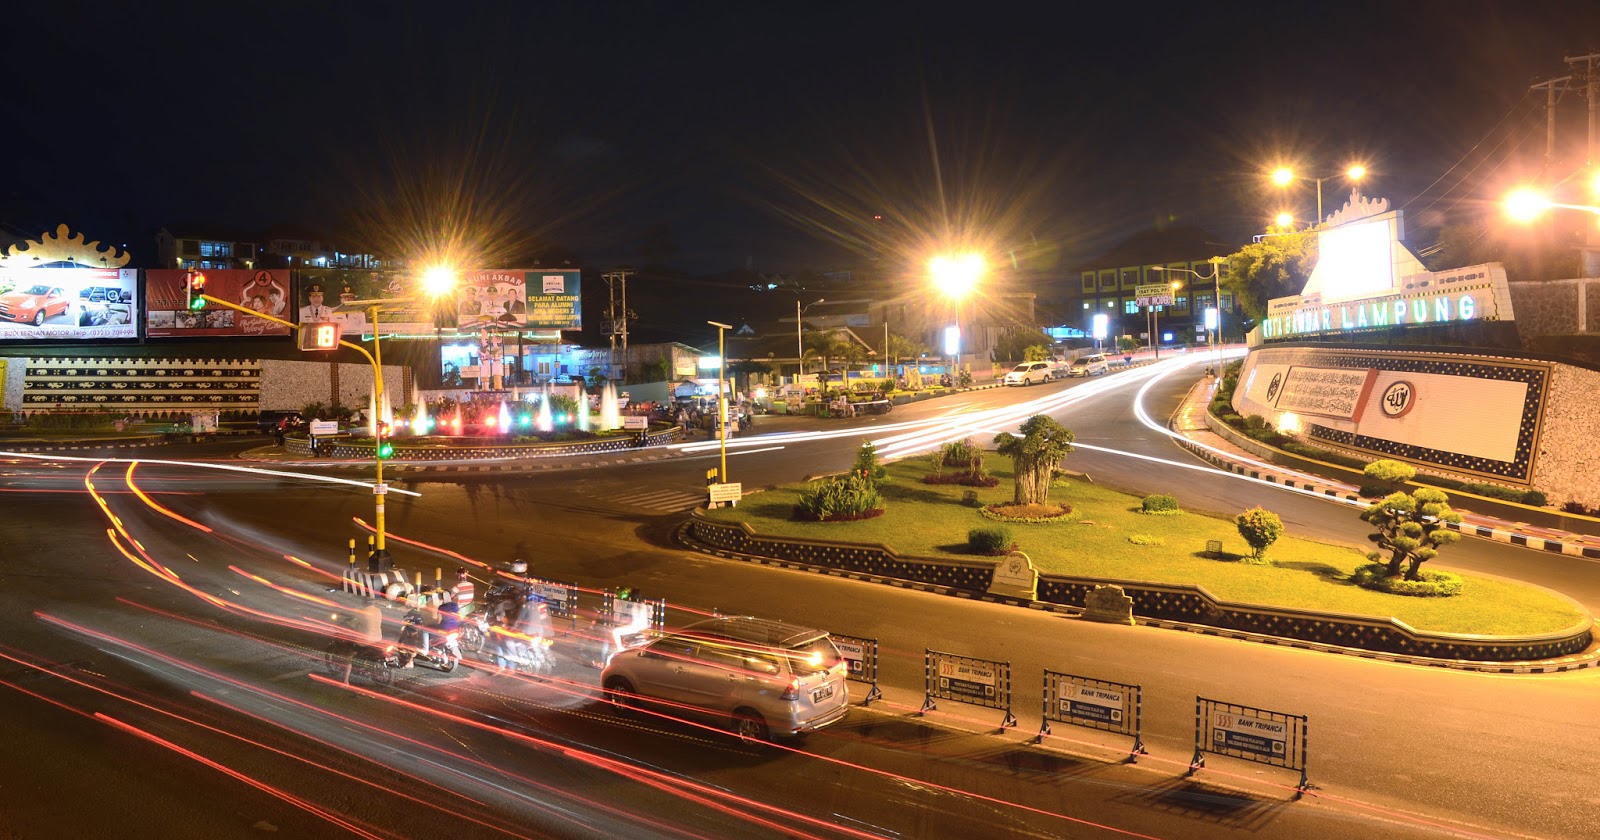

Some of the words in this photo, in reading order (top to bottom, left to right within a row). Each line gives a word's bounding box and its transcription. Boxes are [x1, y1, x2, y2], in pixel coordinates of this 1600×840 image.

[259, 272, 267, 284] 4
[491, 274, 522, 286] AKBAR
[1262, 317, 1282, 338] KOTA
[1285, 308, 1331, 335] BANDAR
[1341, 295, 1475, 329] LAMPUNG
[317, 325, 335, 347] 18
[841, 645, 861, 653] TRIPANCA
[971, 669, 993, 678] TRIPANCA
[1080, 689, 1095, 697] BANK
[1095, 691, 1120, 701] TRIPANCA
[1238, 718, 1254, 728] BANK
[1254, 721, 1283, 733] TRIPANCA
